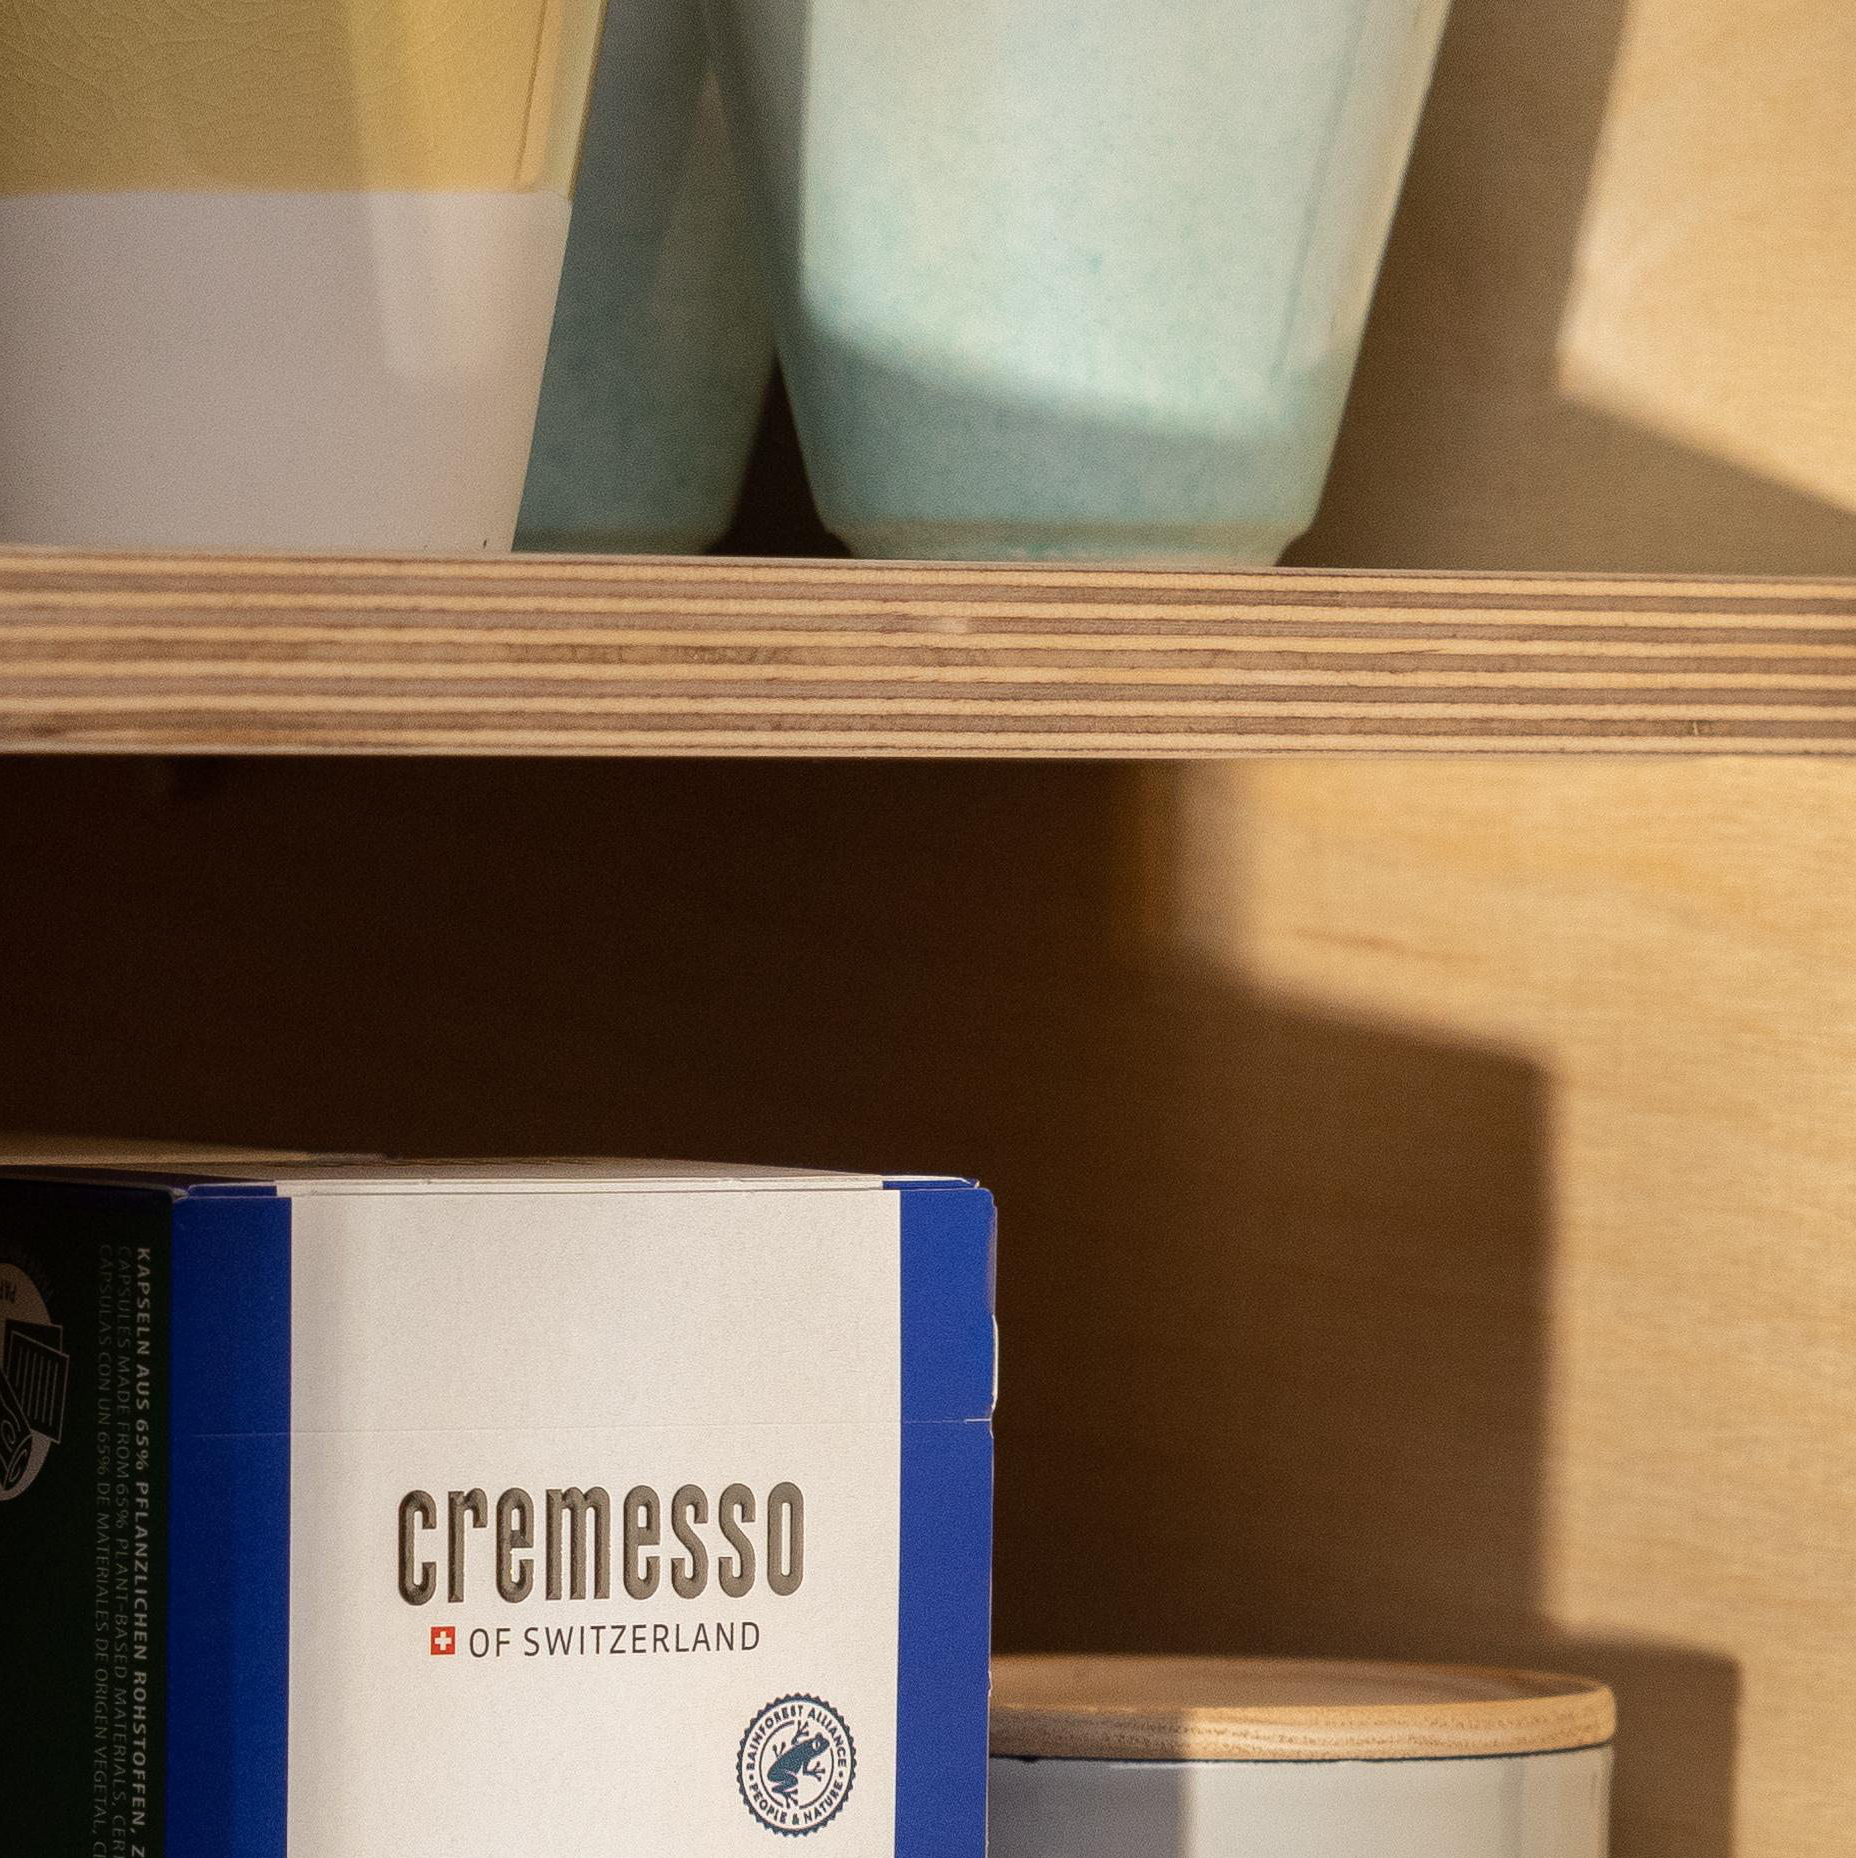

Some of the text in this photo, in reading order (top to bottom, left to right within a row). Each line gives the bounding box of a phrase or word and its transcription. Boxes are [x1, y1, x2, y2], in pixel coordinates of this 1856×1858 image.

[116, 1246, 132, 1349] CAPSULES
[135, 1247, 151, 1356] KAPSELN
[97, 1351, 113, 1391] CON
[115, 1354, 131, 1414] MADE
[135, 1364, 150, 1411] AUS
[97, 1398, 112, 1425] UN
[97, 1431, 112, 1476] 65%
[115, 1421, 130, 1479] FROM
[134, 1418, 149, 1471] 65%
[96, 1482, 111, 1506] DE
[114, 1483, 129, 1529] 65%
[95, 1512, 111, 1632] MATERIALES
[133, 1482, 149, 1660] PFLANZLICHEN
[398, 1481, 805, 1606] cremesso
[113, 1538, 129, 1679] PLANT-BASED
[95, 1638, 109, 1662] DE
[469, 1621, 761, 1658] OF SWITZERLAND
[94, 1667, 109, 1739] ORIGEN
[111, 1687, 127, 1806] MATERIALS,
[130, 1671, 147, 1834] ROHSTOFFEN,
[746, 1705, 846, 1770] RAINFOREST ALLIANCE
[92, 1746, 108, 1835] VEGETAL,
[749, 1782, 788, 1824] PEOPLE
[804, 1780, 843, 1824] NATURE
